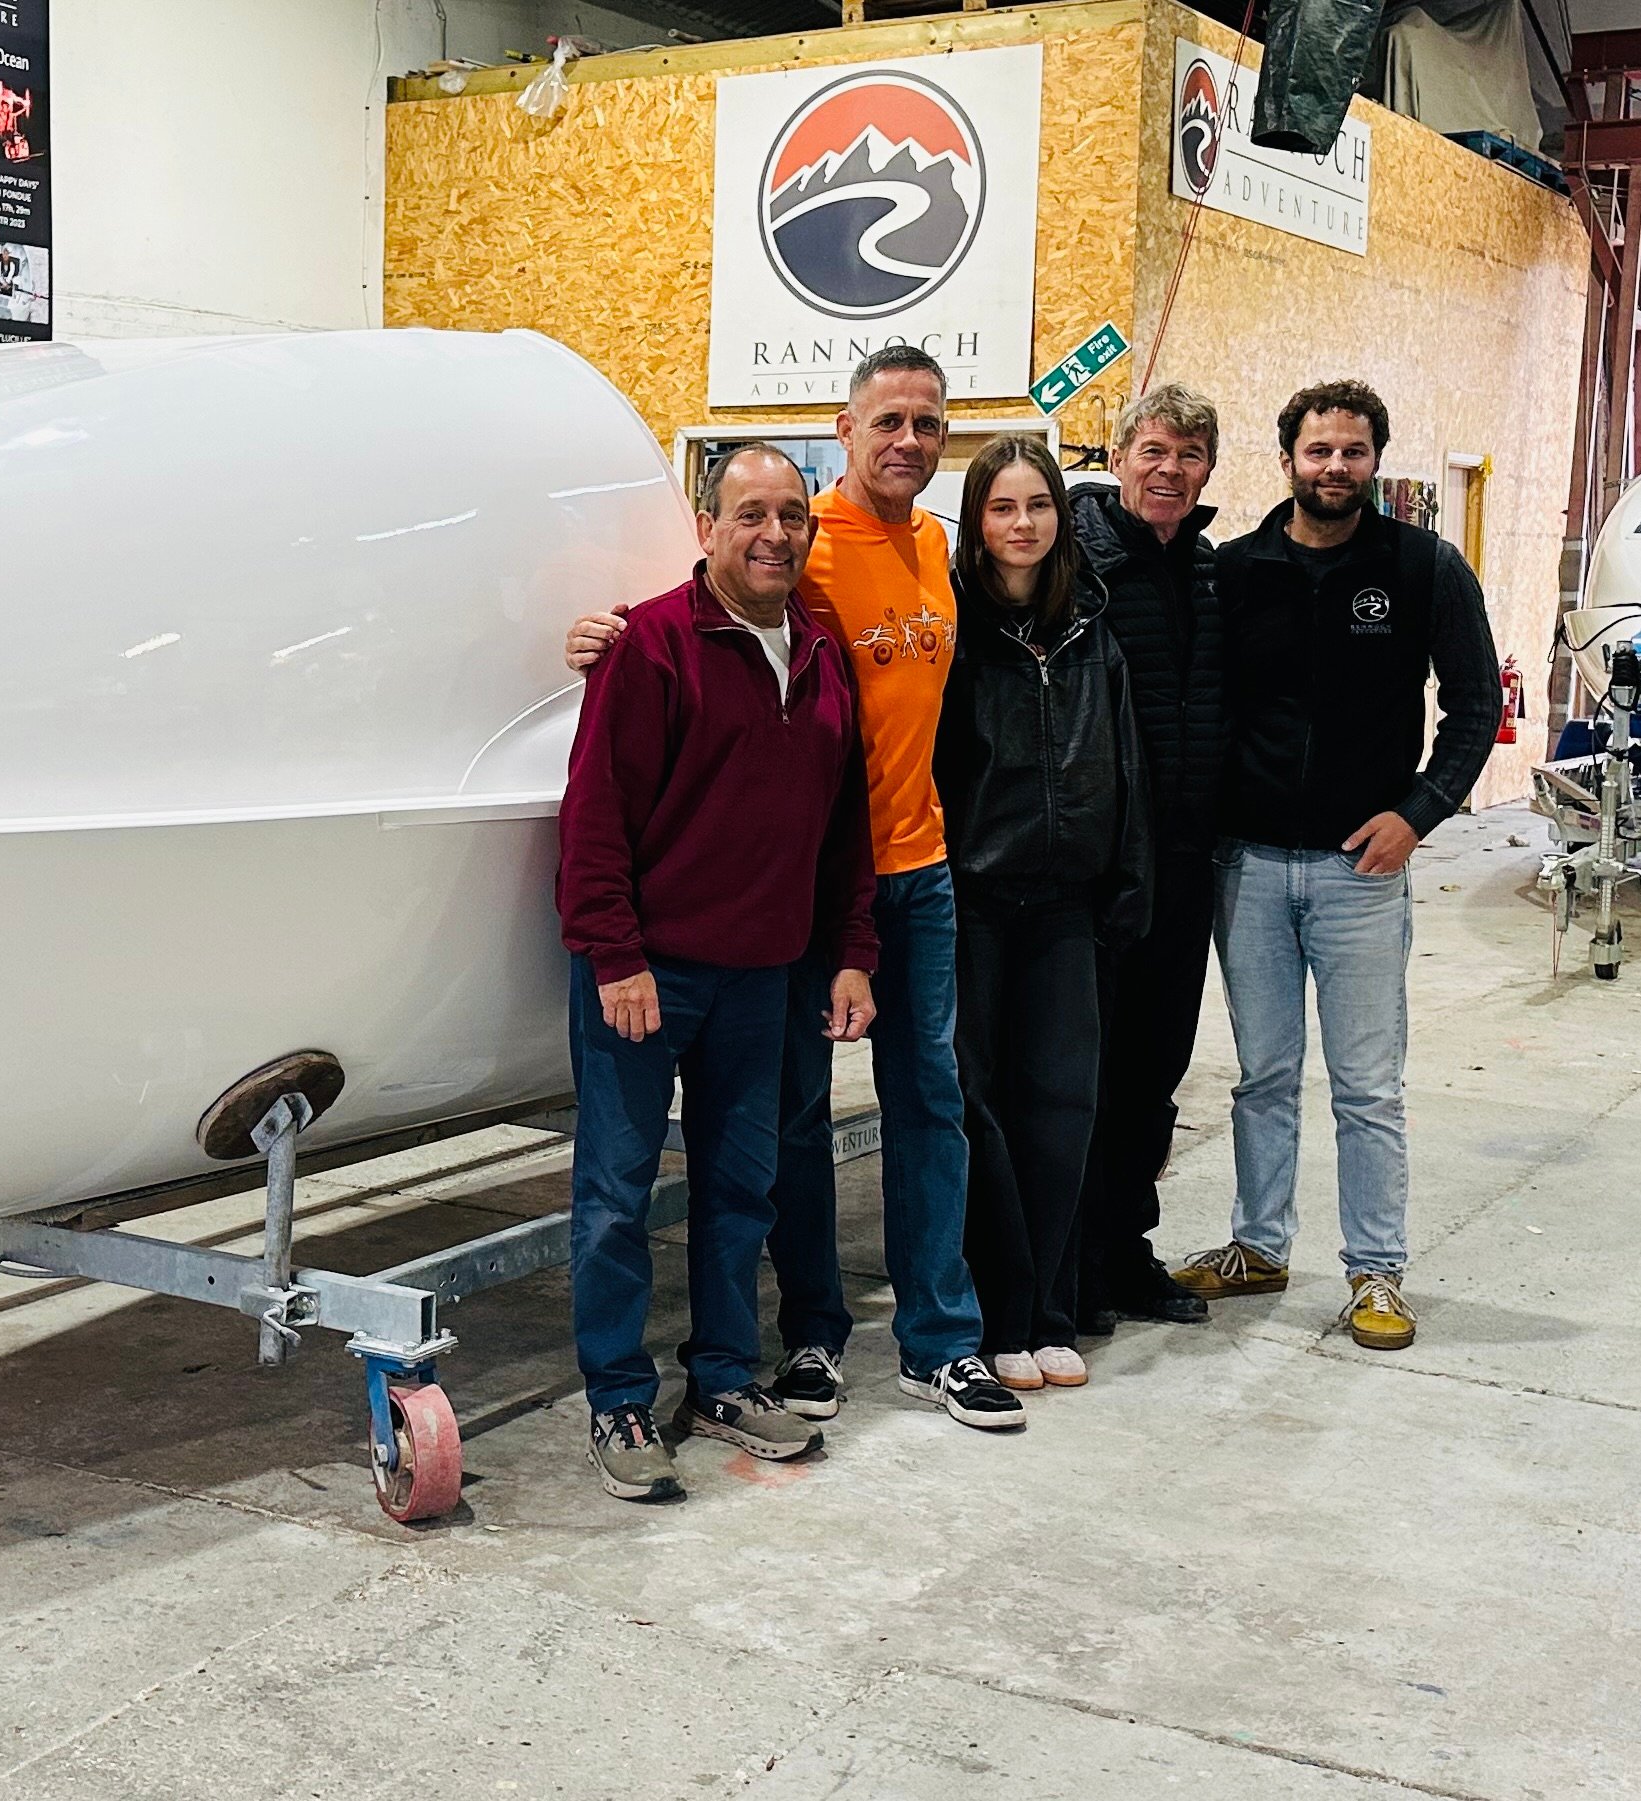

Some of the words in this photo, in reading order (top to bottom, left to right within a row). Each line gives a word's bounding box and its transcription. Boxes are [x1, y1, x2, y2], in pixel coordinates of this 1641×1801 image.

[1223, 169, 1364, 241] ADVENTURE
[1086, 334, 1110, 355] Fire
[1097, 343, 1118, 364] exit
[751, 374, 978, 397] ADVEE
[832, 1126, 880, 1155] VENTUR
